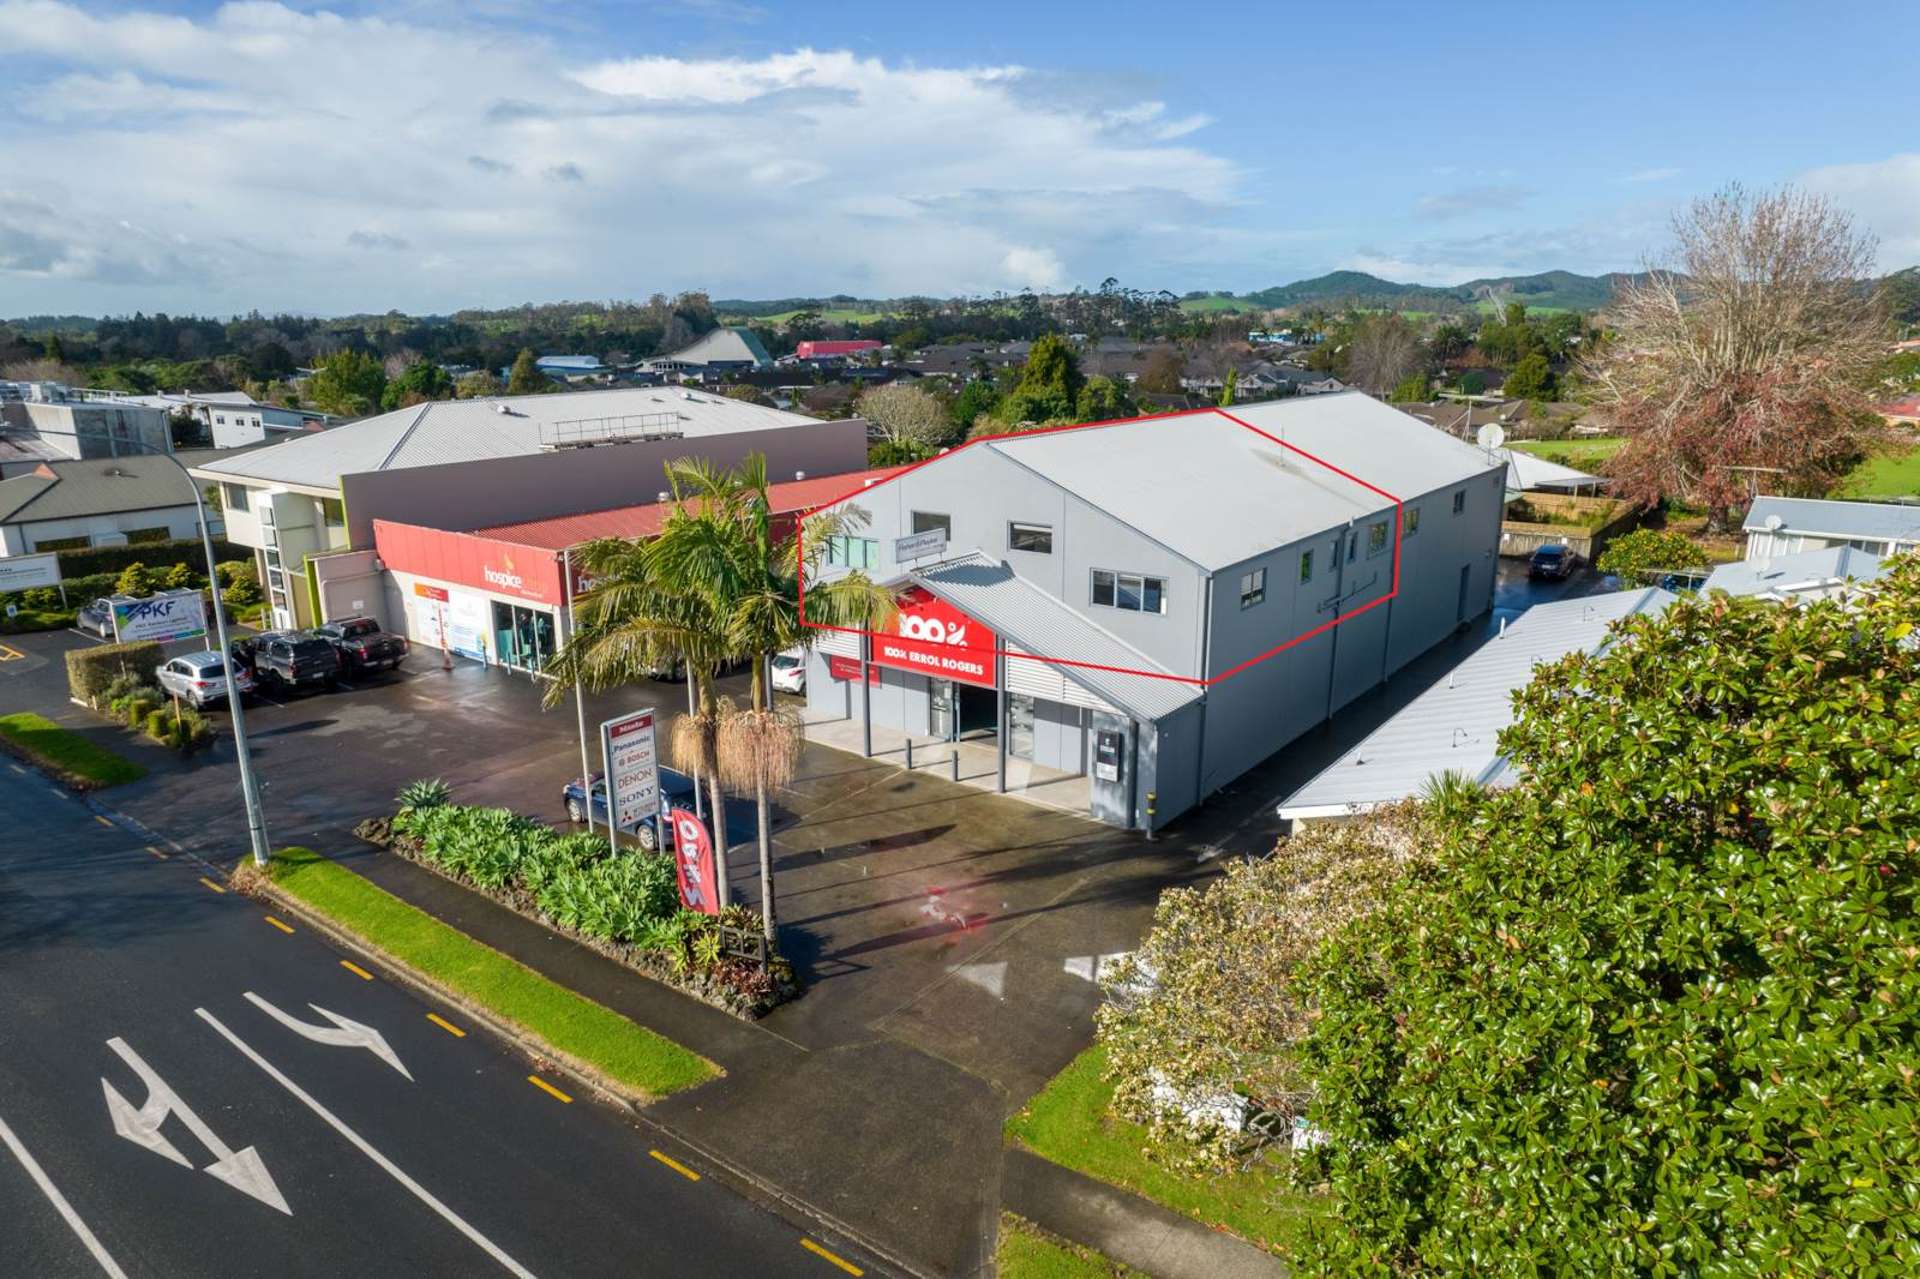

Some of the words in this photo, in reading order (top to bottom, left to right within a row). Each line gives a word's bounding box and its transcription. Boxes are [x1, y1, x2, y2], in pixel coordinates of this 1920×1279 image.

[484, 565, 522, 589] hospice
[141, 601, 176, 620] PKF
[884, 646, 907, 661] 100%
[909, 651, 940, 667] ERROL
[942, 657, 984, 676] ROGERS
[614, 735, 651, 752] Panasonic
[627, 751, 650, 764] BOSCH
[618, 767, 652, 789] DENON
[619, 785, 653, 806] SONY
